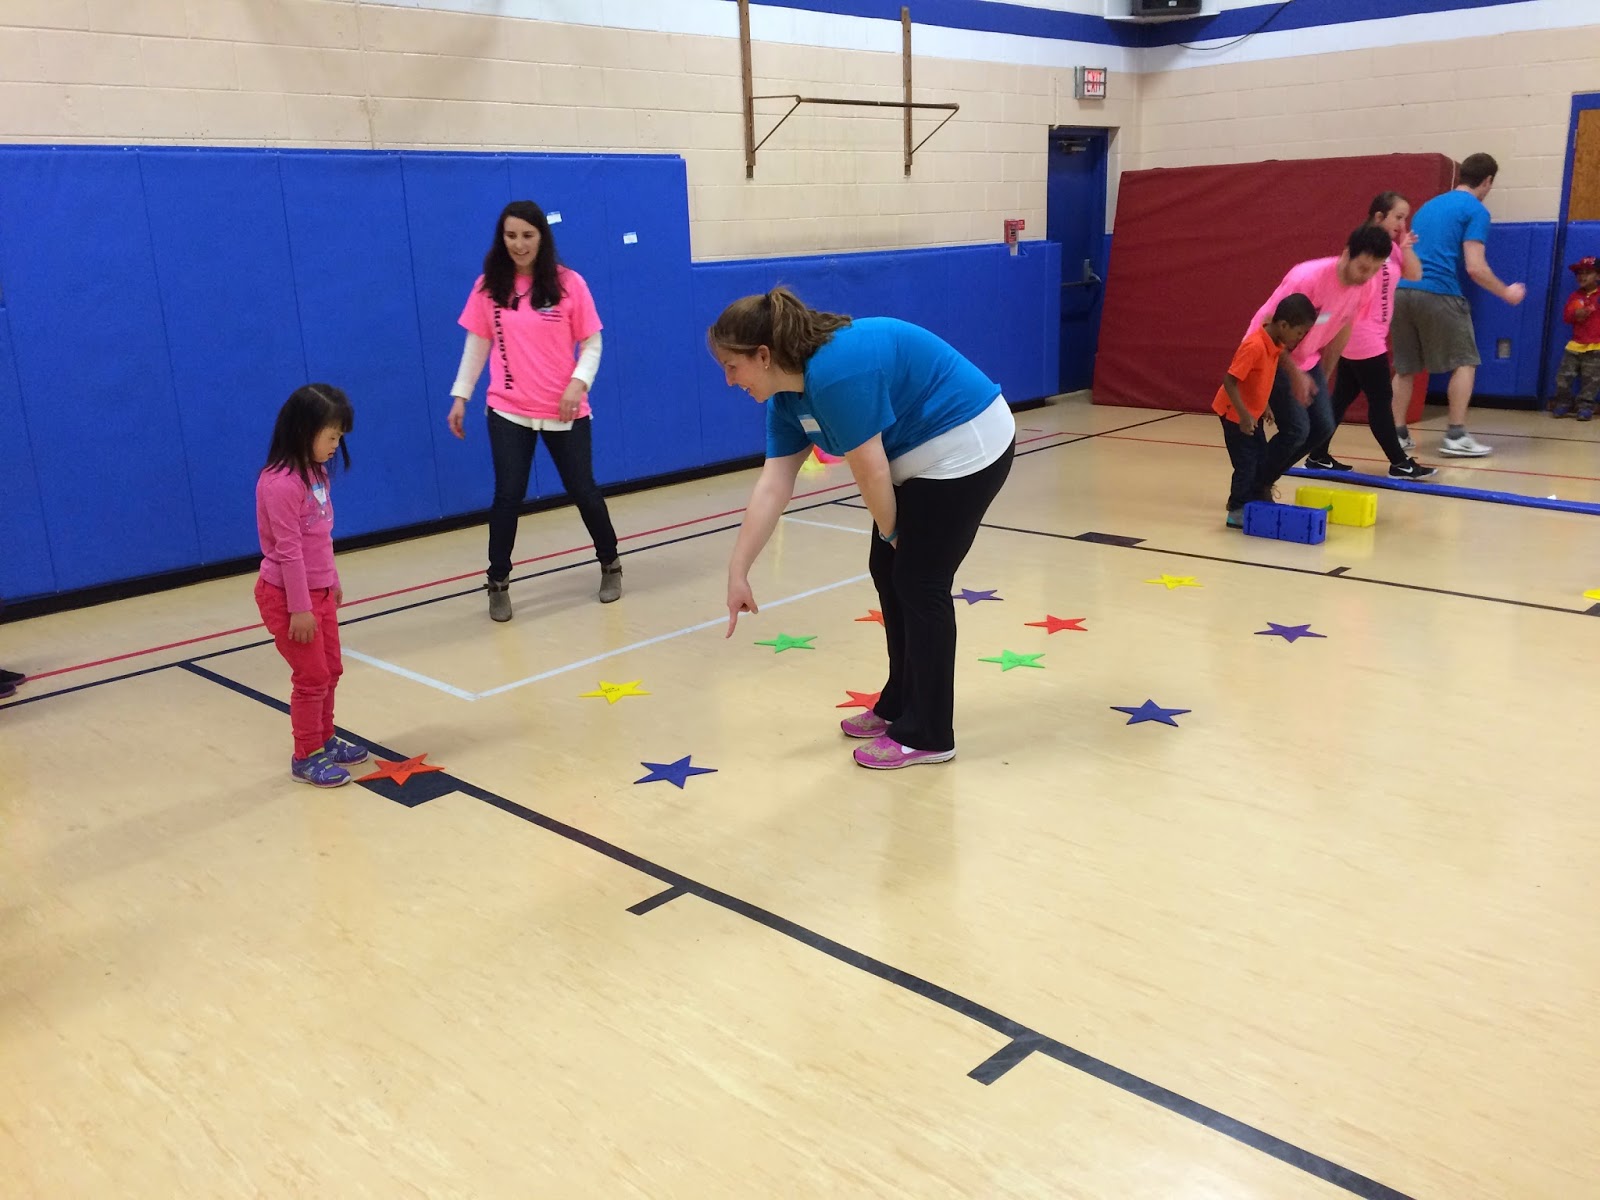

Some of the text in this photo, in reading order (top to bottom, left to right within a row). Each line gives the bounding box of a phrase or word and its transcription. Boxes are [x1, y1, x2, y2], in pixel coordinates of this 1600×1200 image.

[1086, 70, 1102, 93] EXIT
[1381, 264, 1390, 322] PHILADELPH
[493, 305, 514, 390] PHILADELPHI
